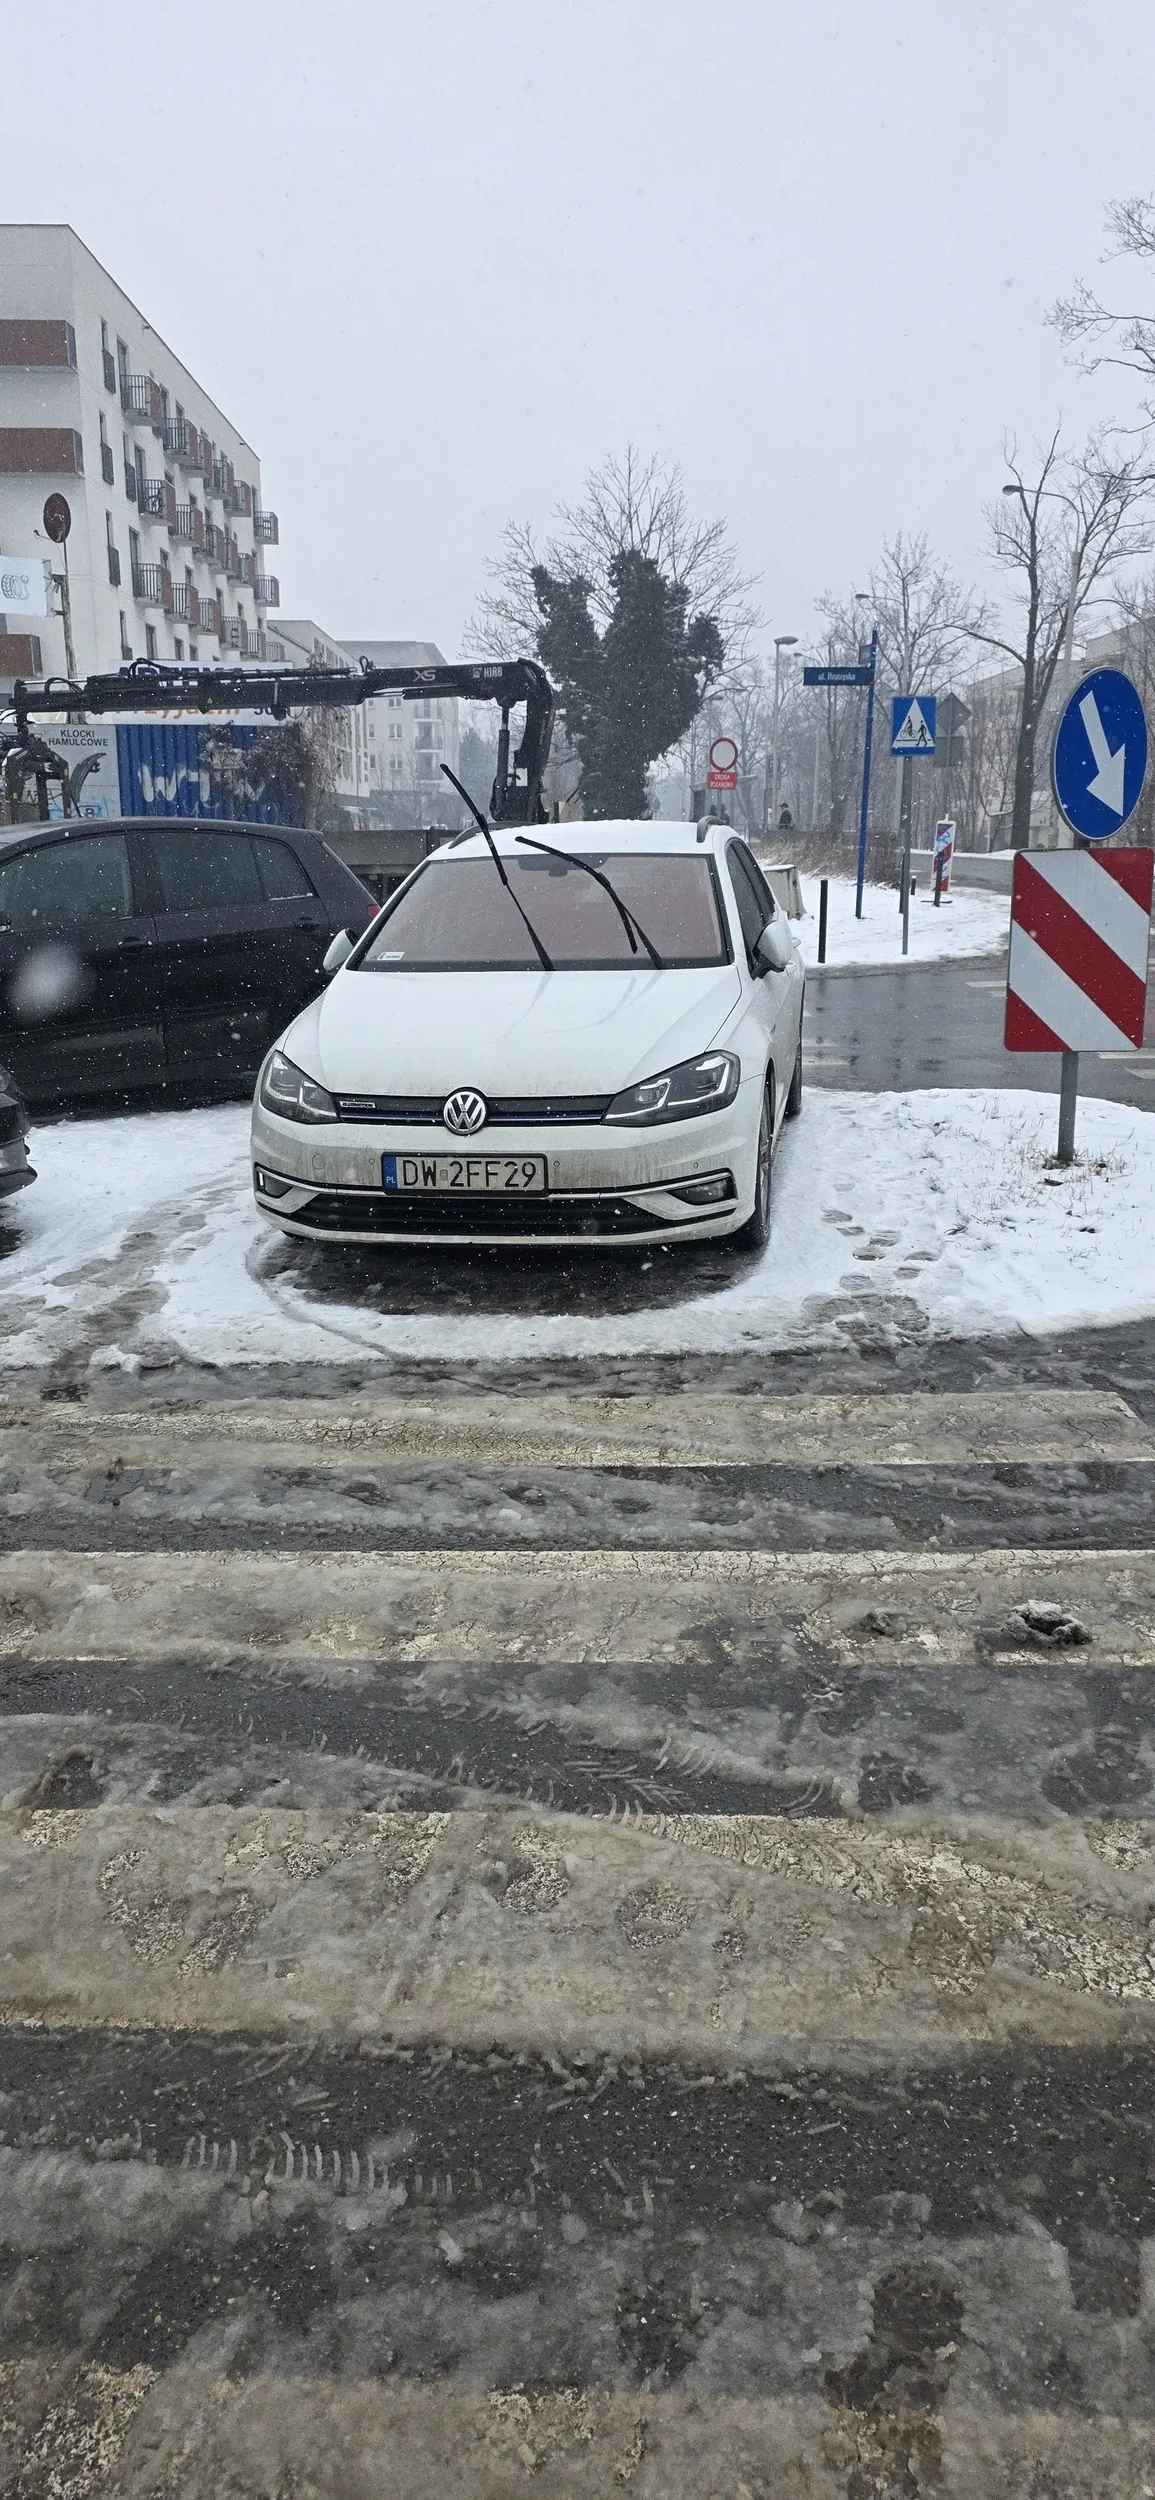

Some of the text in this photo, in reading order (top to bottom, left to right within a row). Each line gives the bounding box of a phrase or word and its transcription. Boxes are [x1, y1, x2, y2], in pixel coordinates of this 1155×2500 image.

[413, 669, 437, 682] XS
[483, 666, 503, 678] HIAB
[60, 729, 95, 738] KLOCKI
[48, 738, 109, 746] HAMULCOWE
[403, 1160, 537, 1188] DW 2FF29
[386, 1176, 396, 1184] PL
